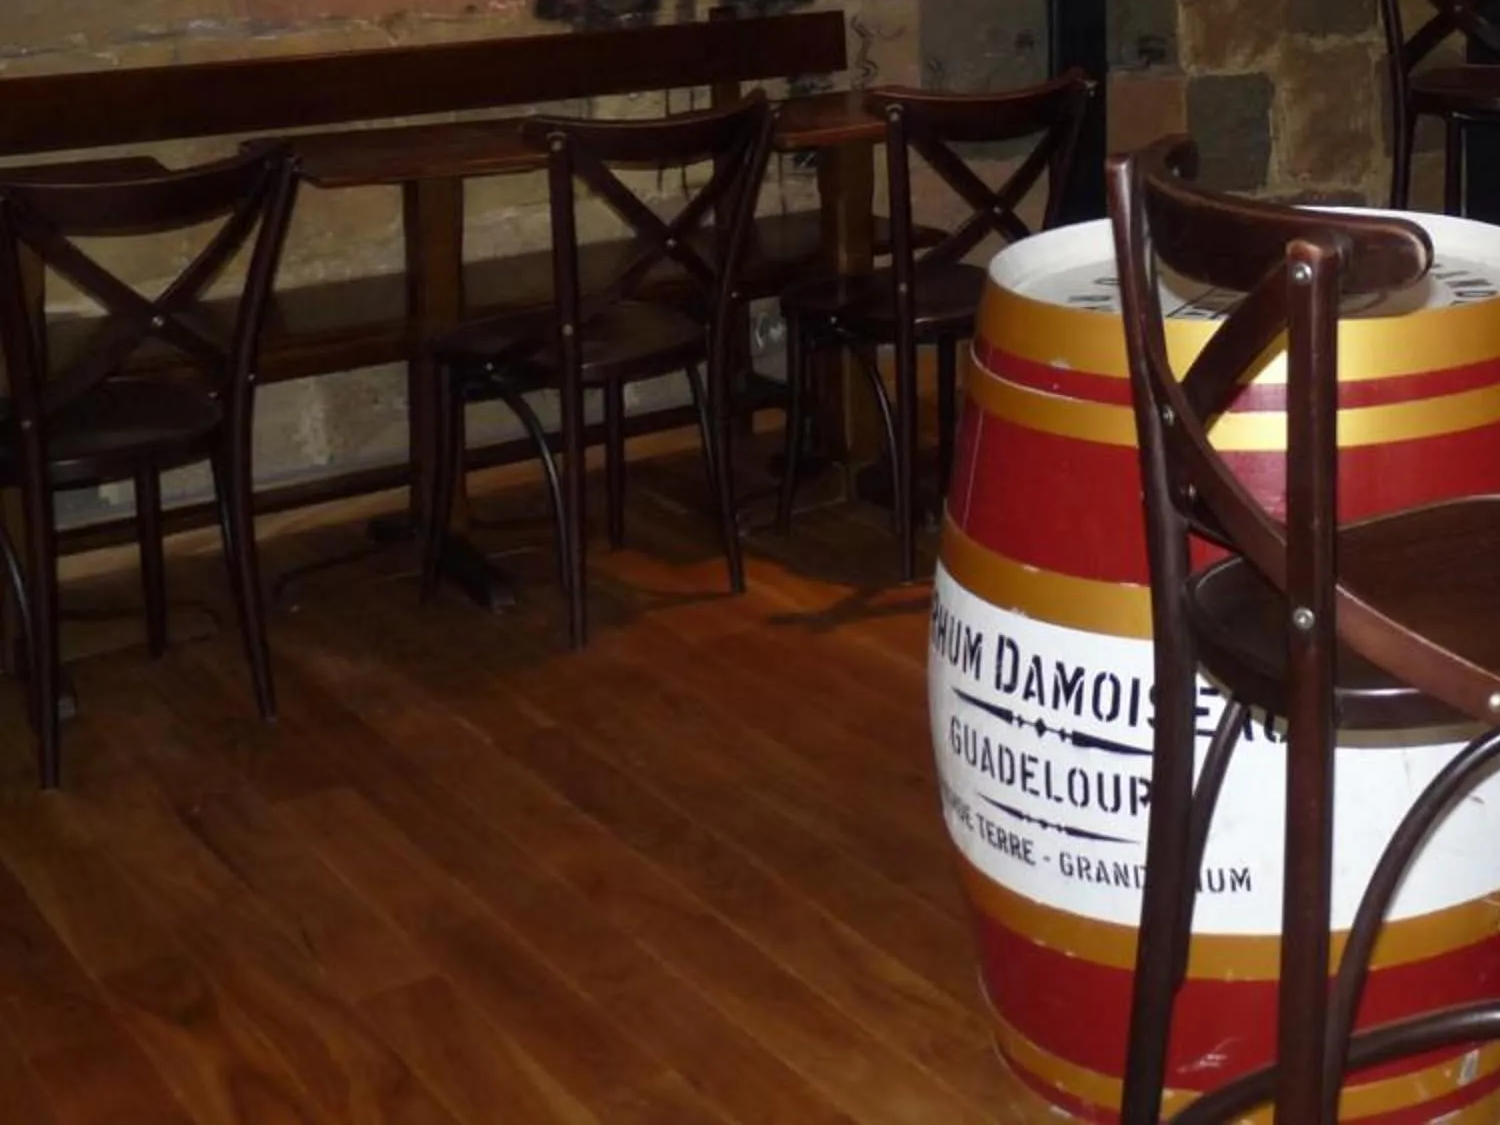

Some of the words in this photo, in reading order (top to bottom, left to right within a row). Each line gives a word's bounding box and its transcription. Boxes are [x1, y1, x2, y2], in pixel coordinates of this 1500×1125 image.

[994, 634, 1288, 744] DAMOIE
[950, 716, 1152, 816] GUADELOUP
[976, 813, 1036, 866] TERRE
[1197, 867, 1251, 893] UM
